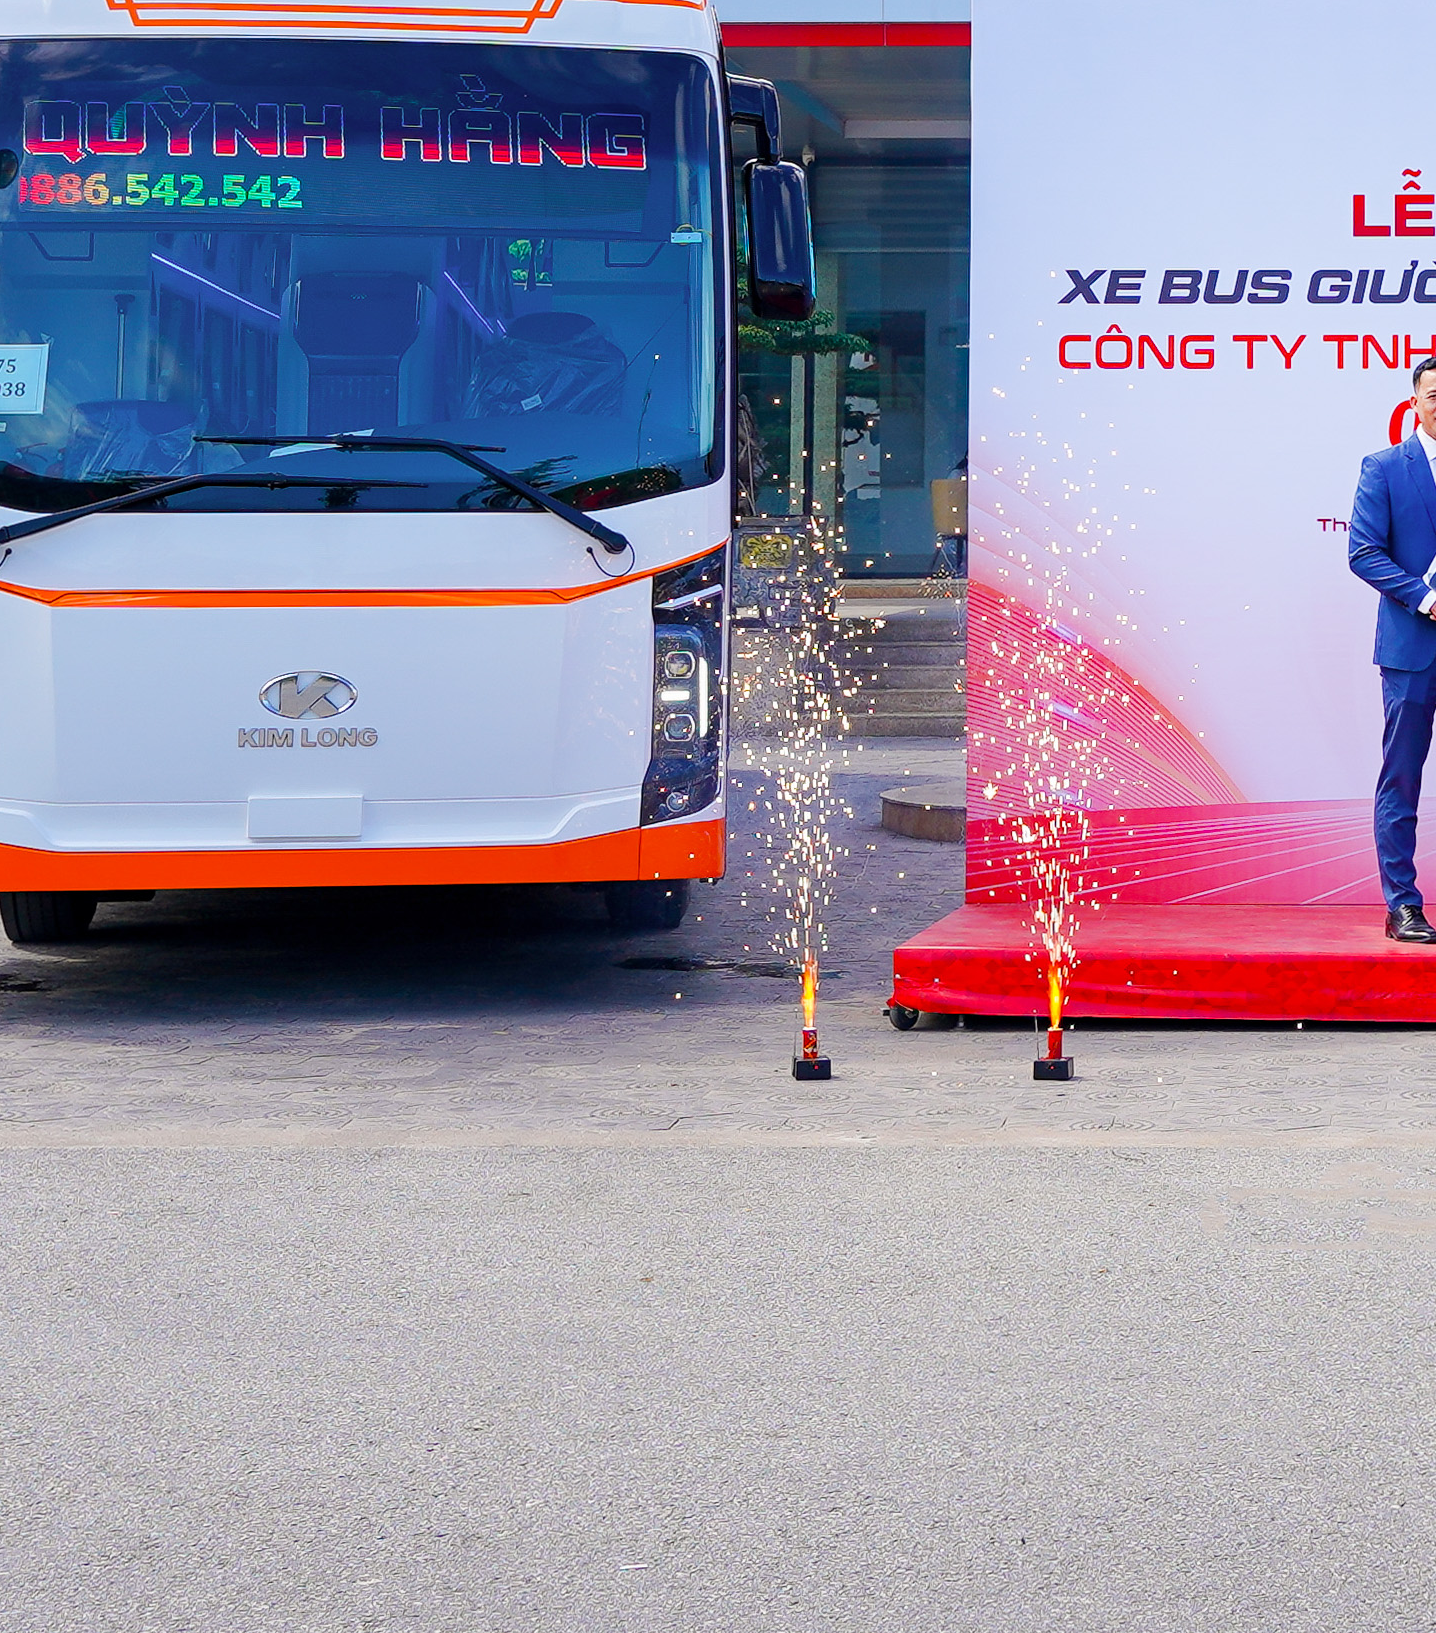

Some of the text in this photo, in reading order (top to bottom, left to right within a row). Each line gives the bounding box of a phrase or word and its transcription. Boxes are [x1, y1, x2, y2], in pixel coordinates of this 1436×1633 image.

[23, 85, 345, 165] QUỲNH
[1352, 168, 1436, 237] LỄ
[1057, 269, 1146, 305] XE
[1157, 269, 1293, 305] BUS
[1058, 323, 1215, 370] CÔNG
[1232, 334, 1307, 370] TY
[237, 727, 379, 748] KIM LONG
